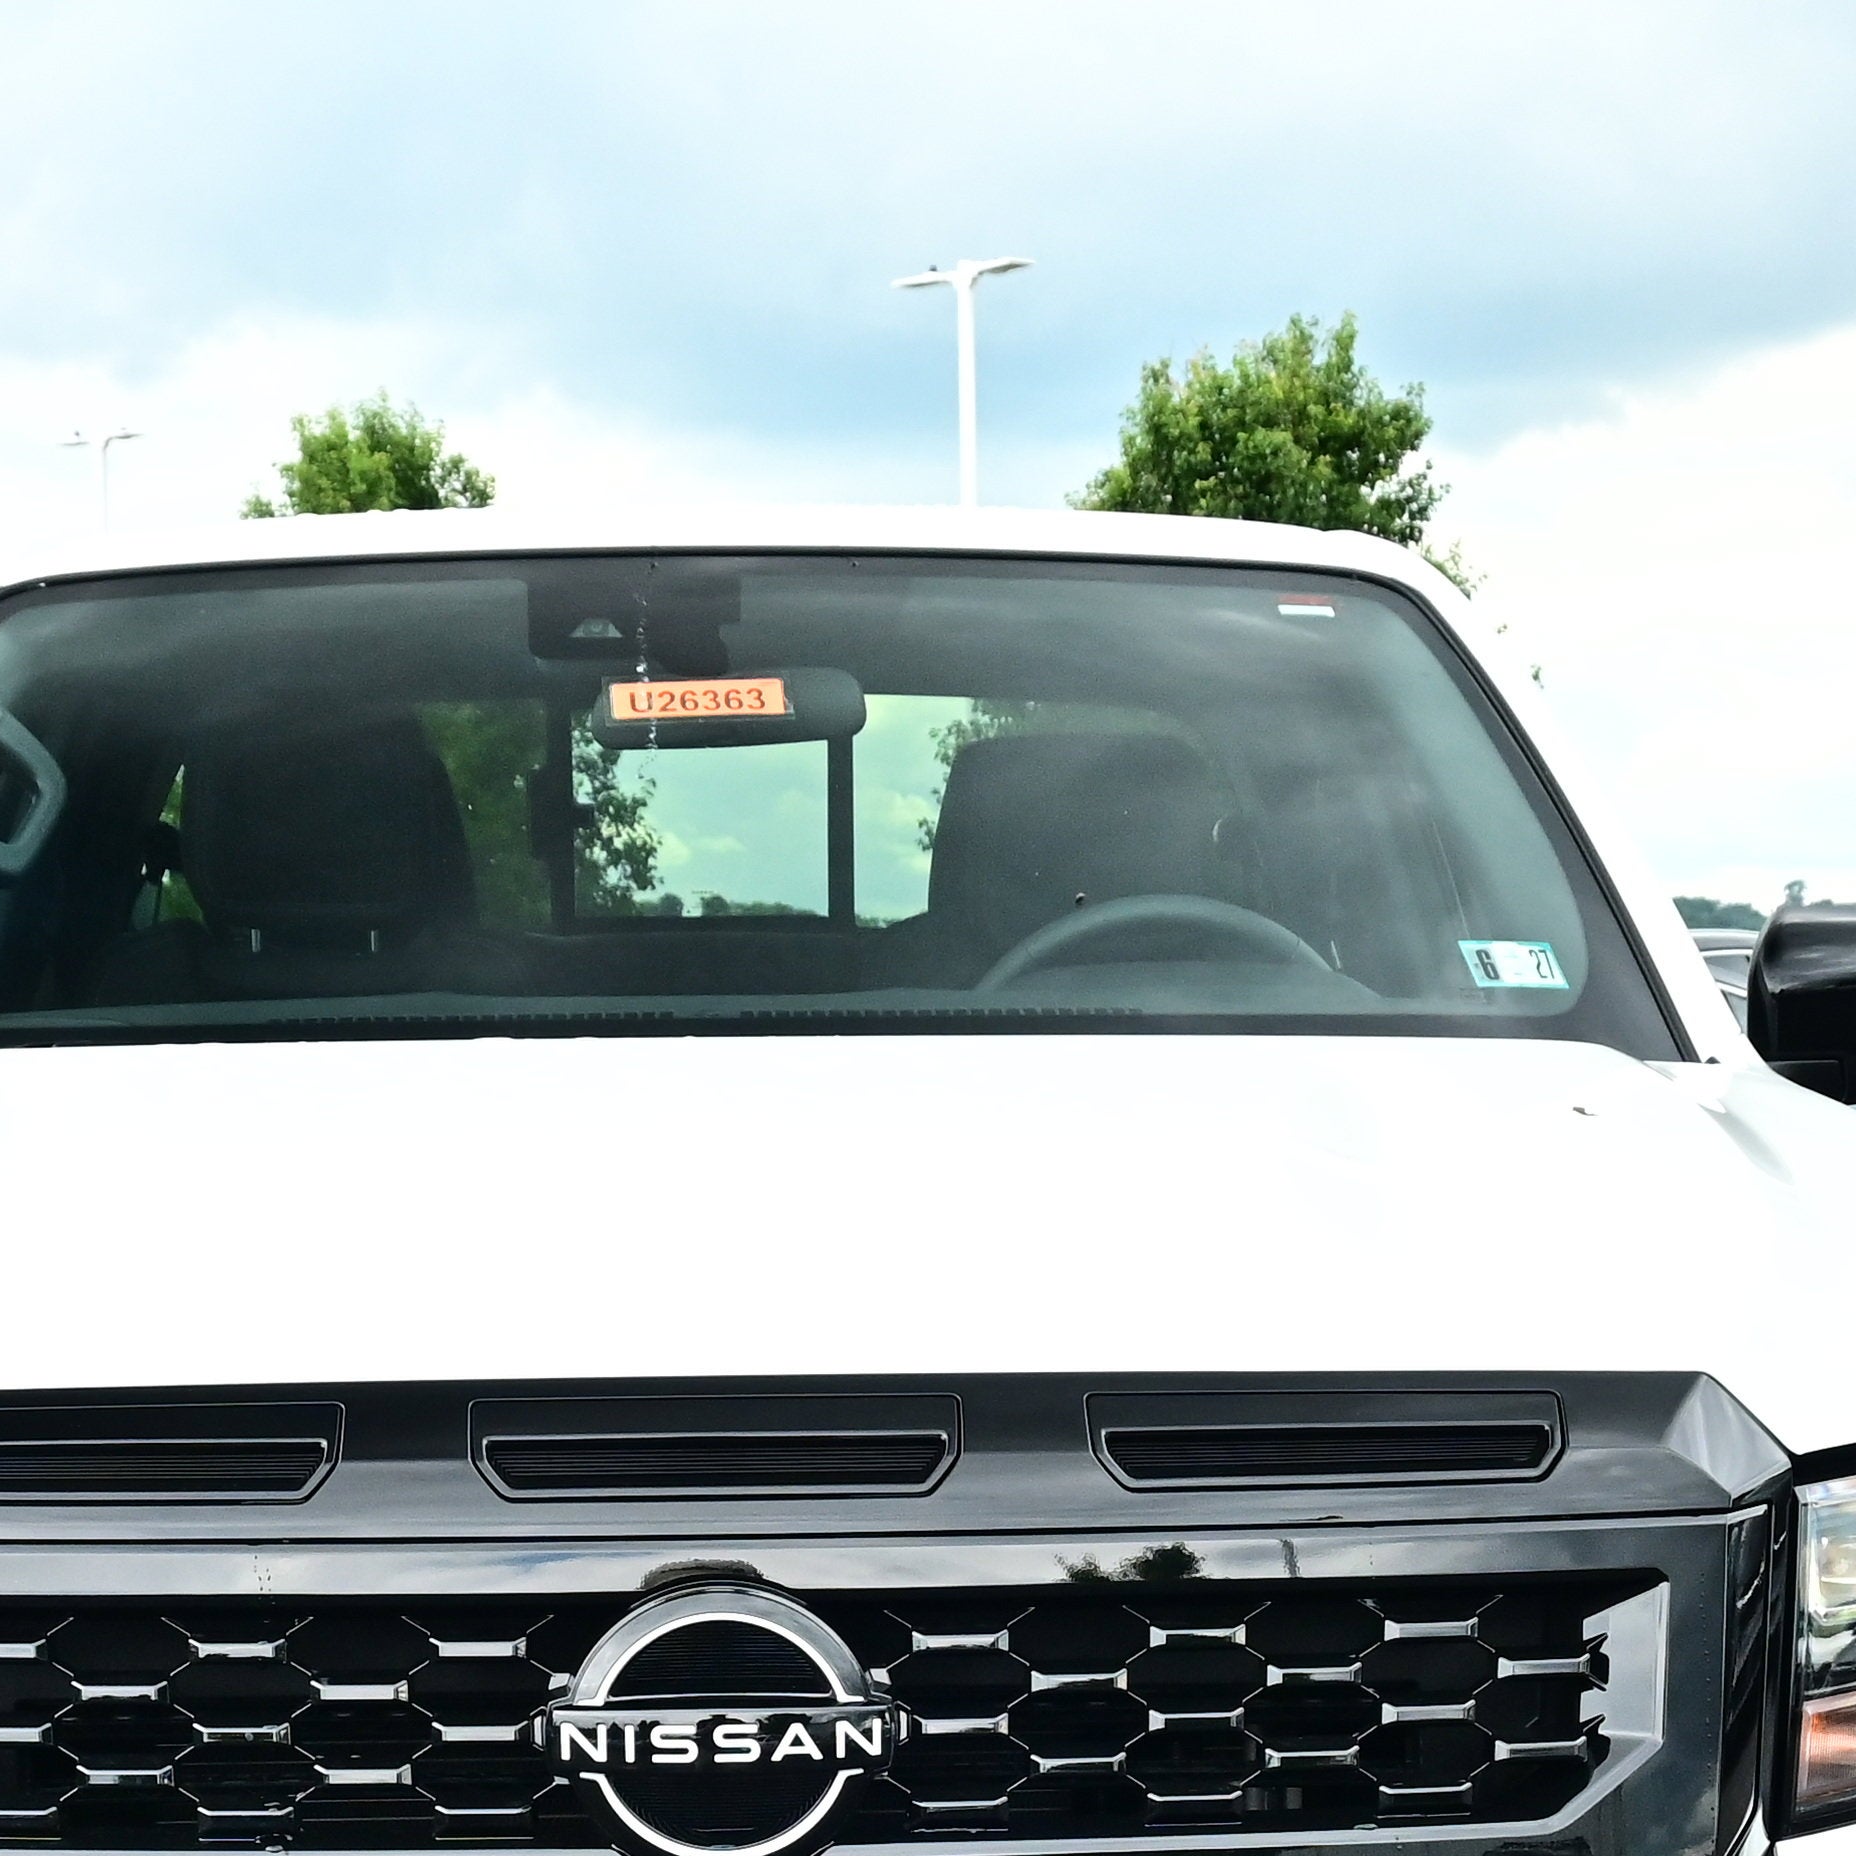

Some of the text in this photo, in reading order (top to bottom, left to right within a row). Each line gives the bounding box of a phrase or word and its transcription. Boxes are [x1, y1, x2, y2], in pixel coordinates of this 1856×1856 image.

[629, 687, 767, 713] U26363
[1475, 949, 1555, 981] 6 27
[559, 1717, 884, 1765] NISSAN
